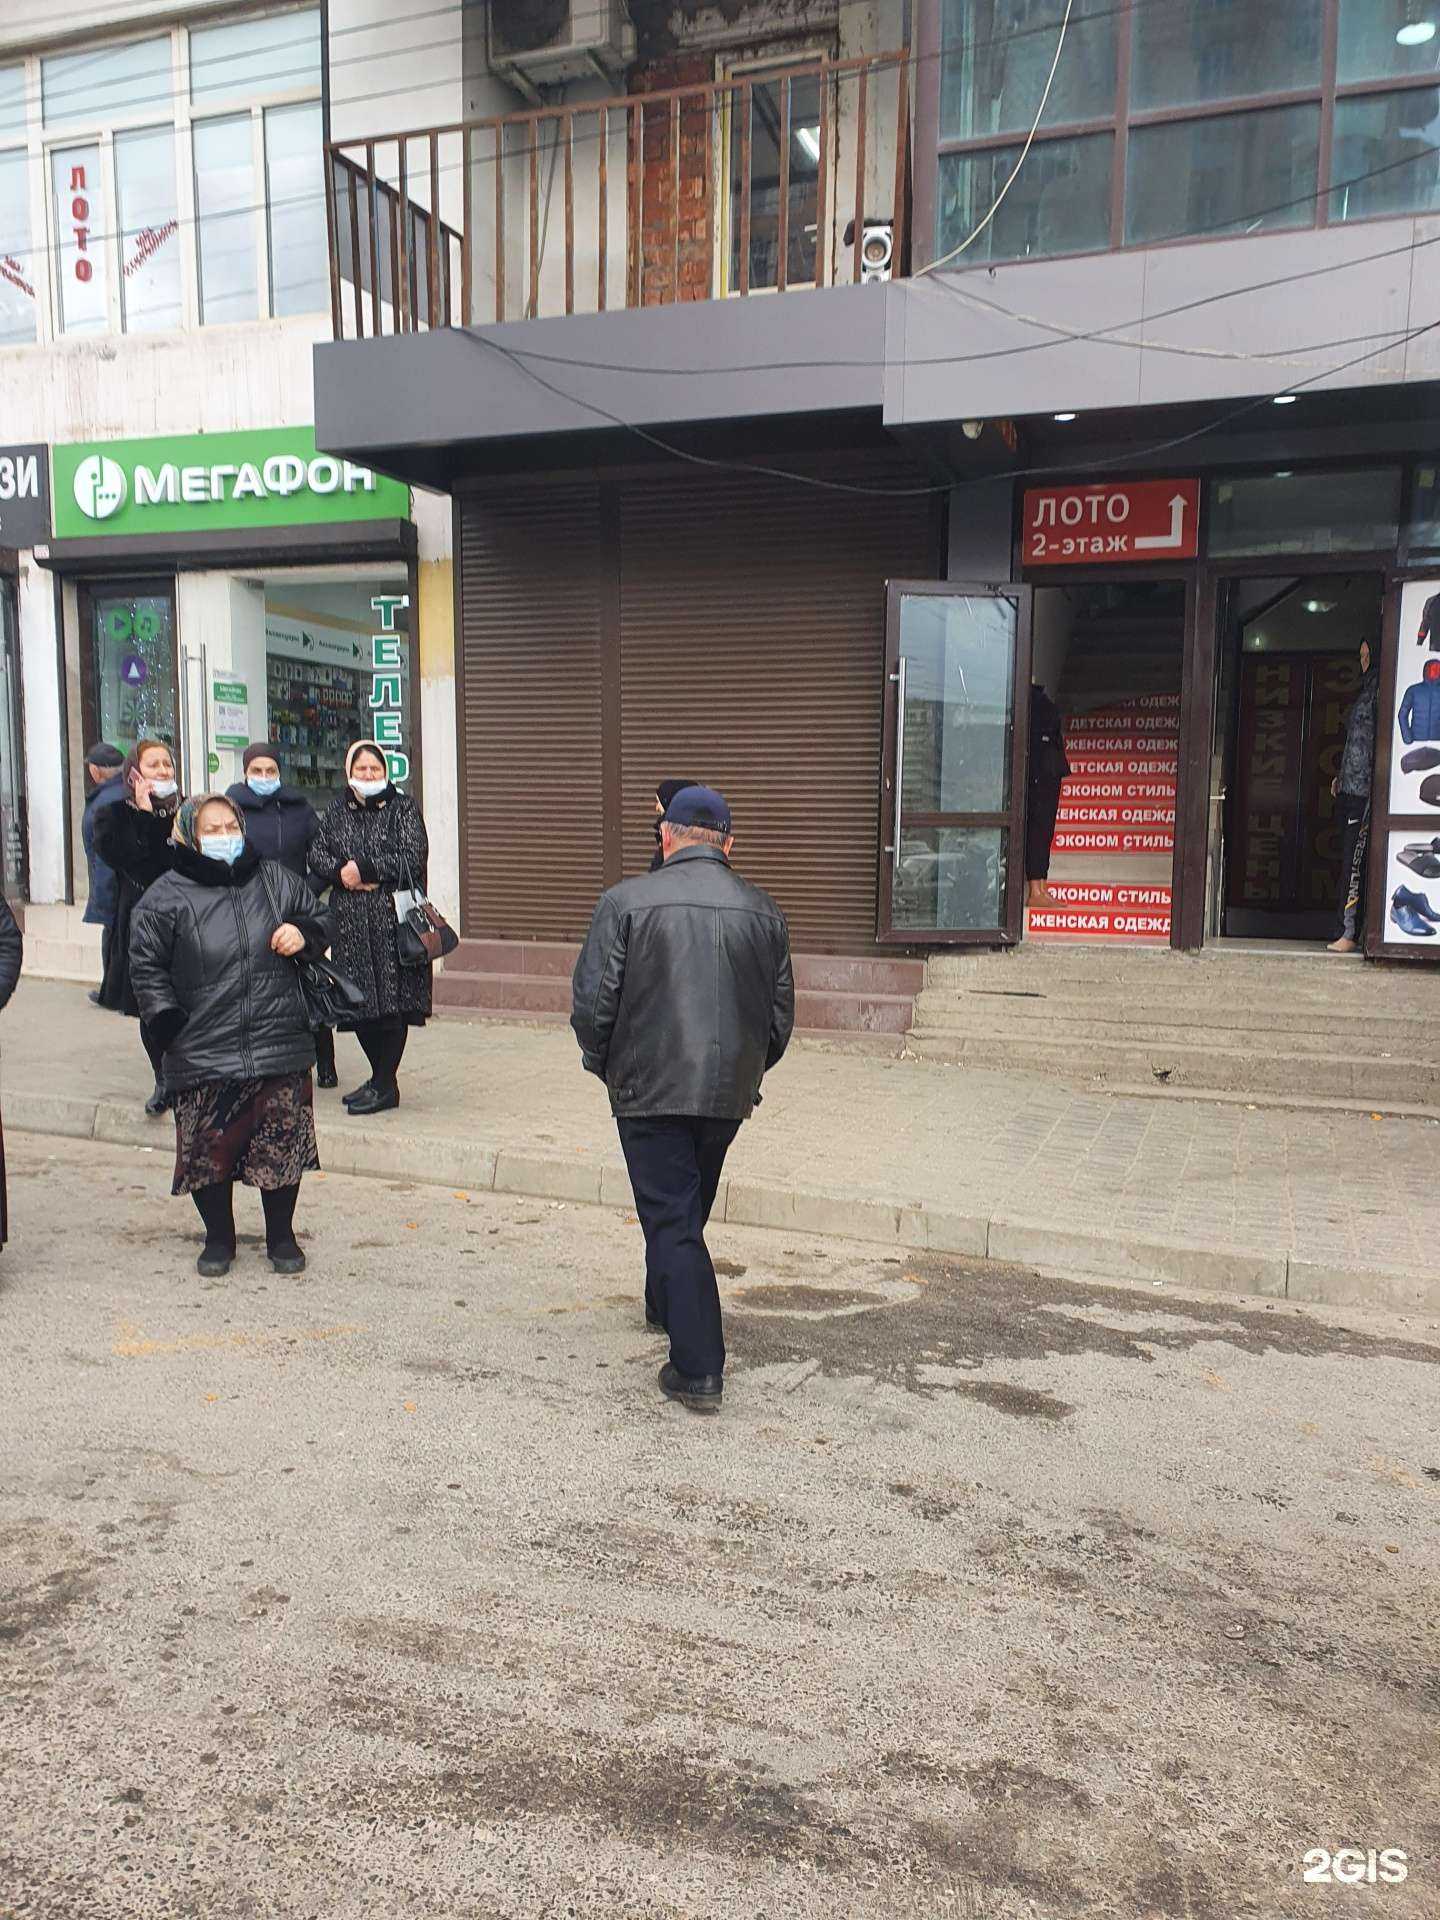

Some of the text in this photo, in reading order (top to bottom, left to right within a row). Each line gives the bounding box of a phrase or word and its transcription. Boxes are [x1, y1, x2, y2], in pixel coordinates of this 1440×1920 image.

[70, 165, 94, 283] ЛОТО
[1031, 493, 1131, 528] ЛОТО
[1031, 534, 1129, 558] 2-этаж
[368, 594, 410, 795] ТЕЛЕФ
[1070, 717, 1180, 730] ДЕТСКАЯ ОДЕЖ
[1066, 739, 1133, 751] ЖЕНСКАЯ
[1069, 762, 1124, 774] ЕТСКАЯ
[1062, 785, 1176, 797] ЭКОНОМ СТИЛЬ
[1121, 808, 1176, 824] ОДЕЖД
[1055, 835, 1174, 848] ЭКОНОМ СТИЛЬ
[1047, 887, 1172, 904] ЭКОНОМ СТИЛЬ
[1030, 913, 1109, 929] ЖЕНСКАЯ
